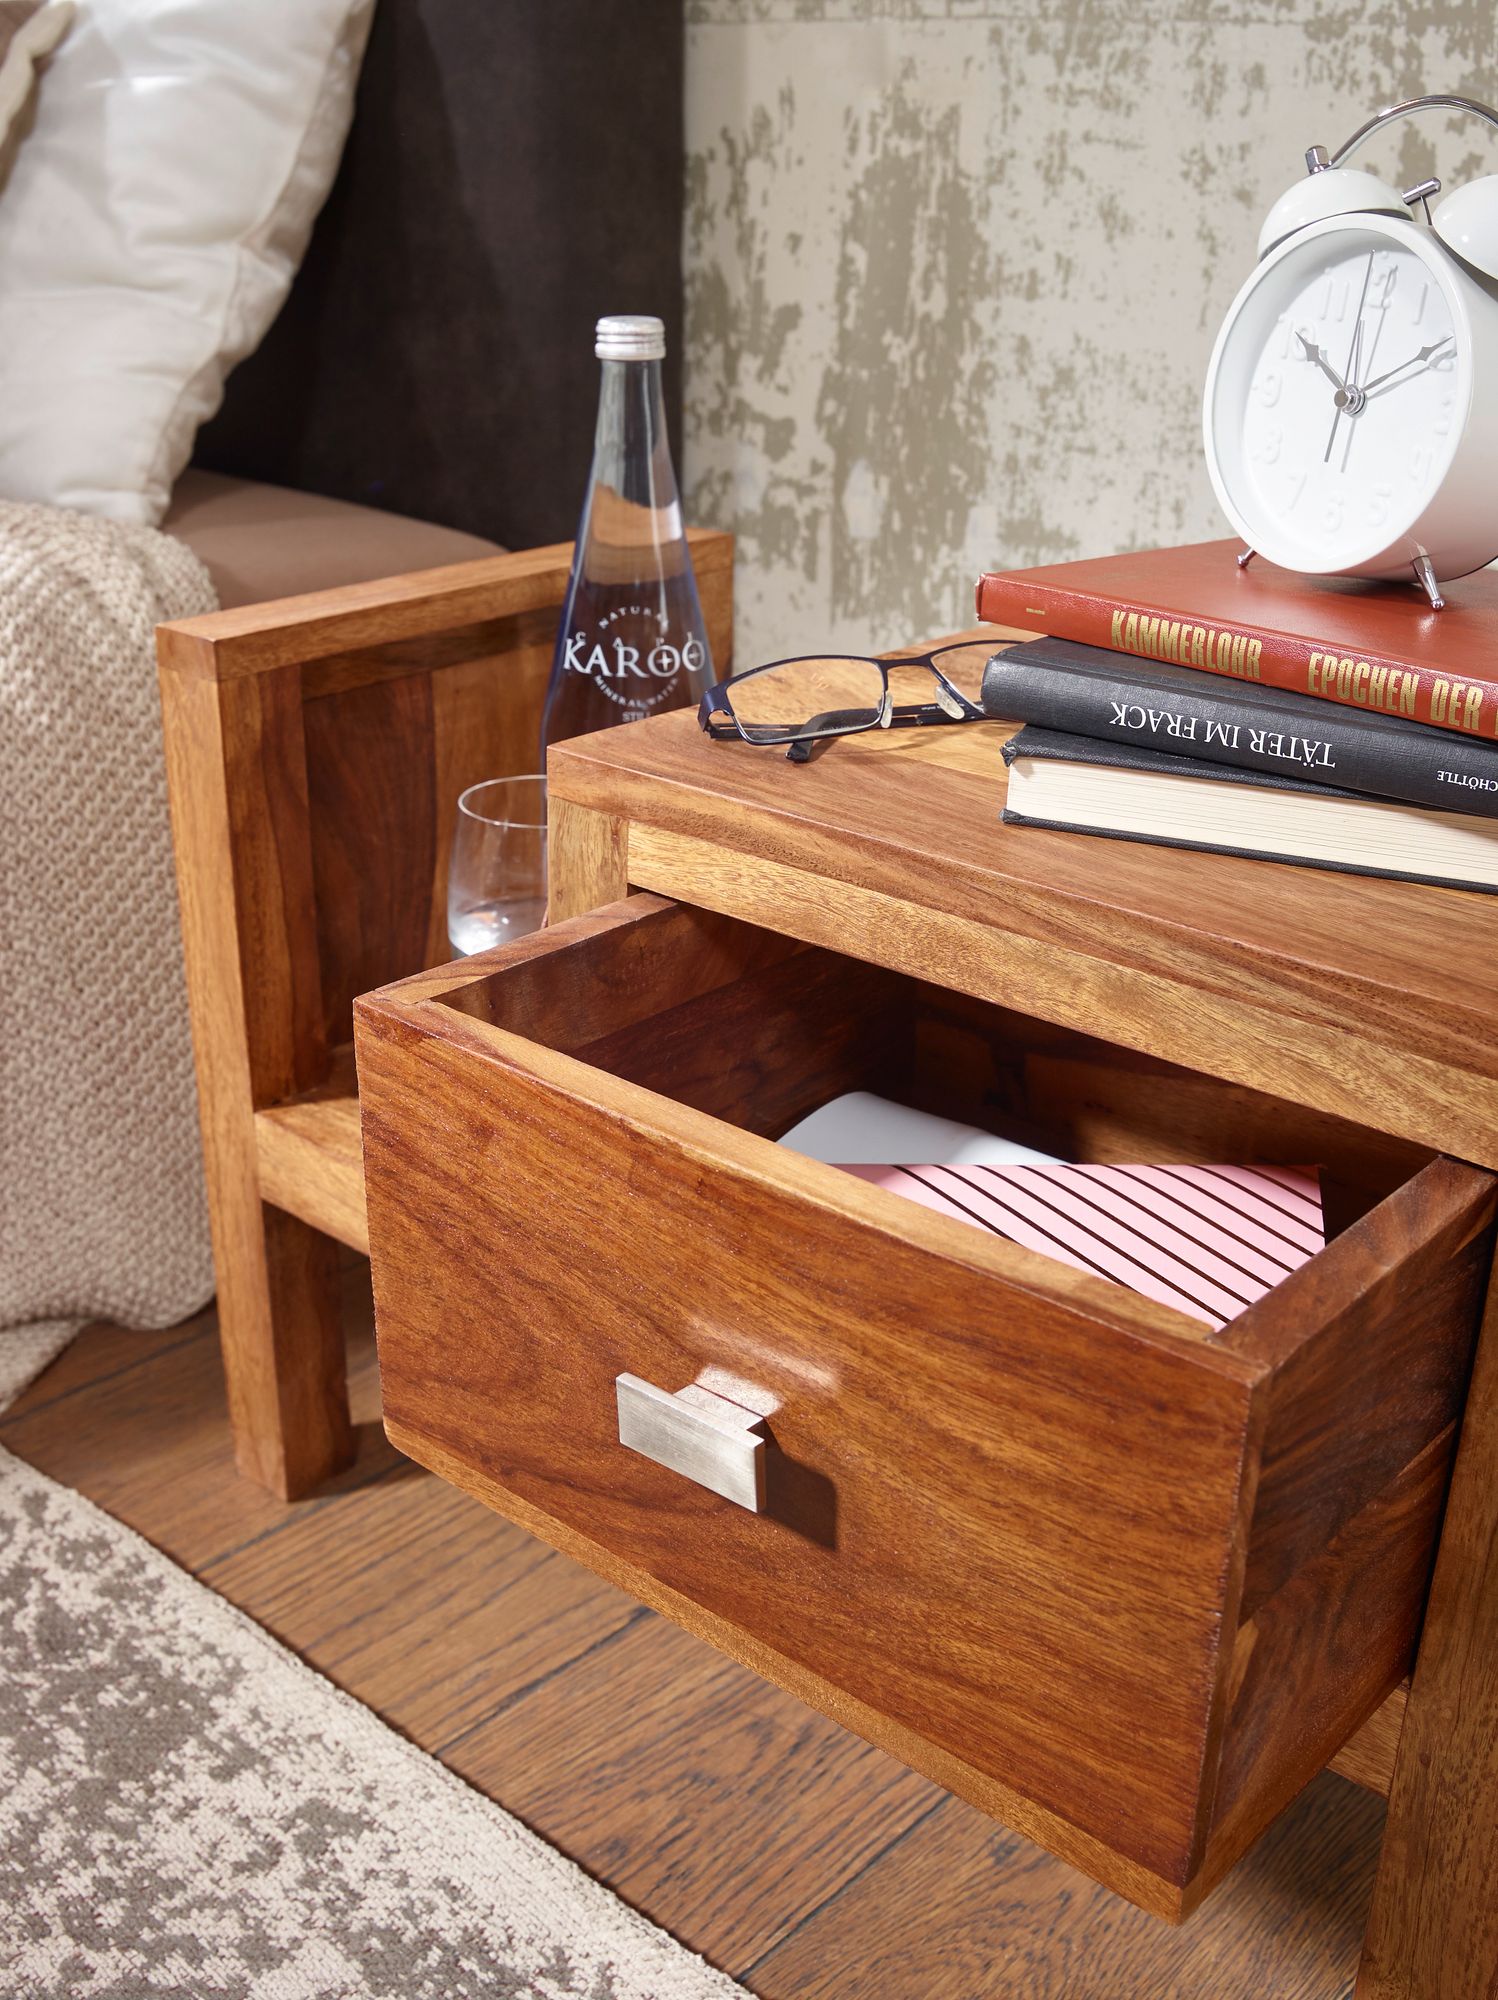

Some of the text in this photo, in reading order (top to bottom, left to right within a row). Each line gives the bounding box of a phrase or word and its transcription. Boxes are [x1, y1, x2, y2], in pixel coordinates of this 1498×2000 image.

[1320, 275, 1350, 321] 11
[1412, 281, 1429, 325] 1
[1261, 367, 1284, 408] 9
[1287, 471, 1308, 511] 7
[563, 637, 706, 678] KAROO
[1111, 609, 1262, 679] KAMMERLOHR
[594, 674, 644, 709] MINERAL
[1307, 651, 1420, 715] EPOCHEN
[1430, 678, 1484, 731] DER
[1109, 702, 1336, 769] TÄTER IM FRACK
